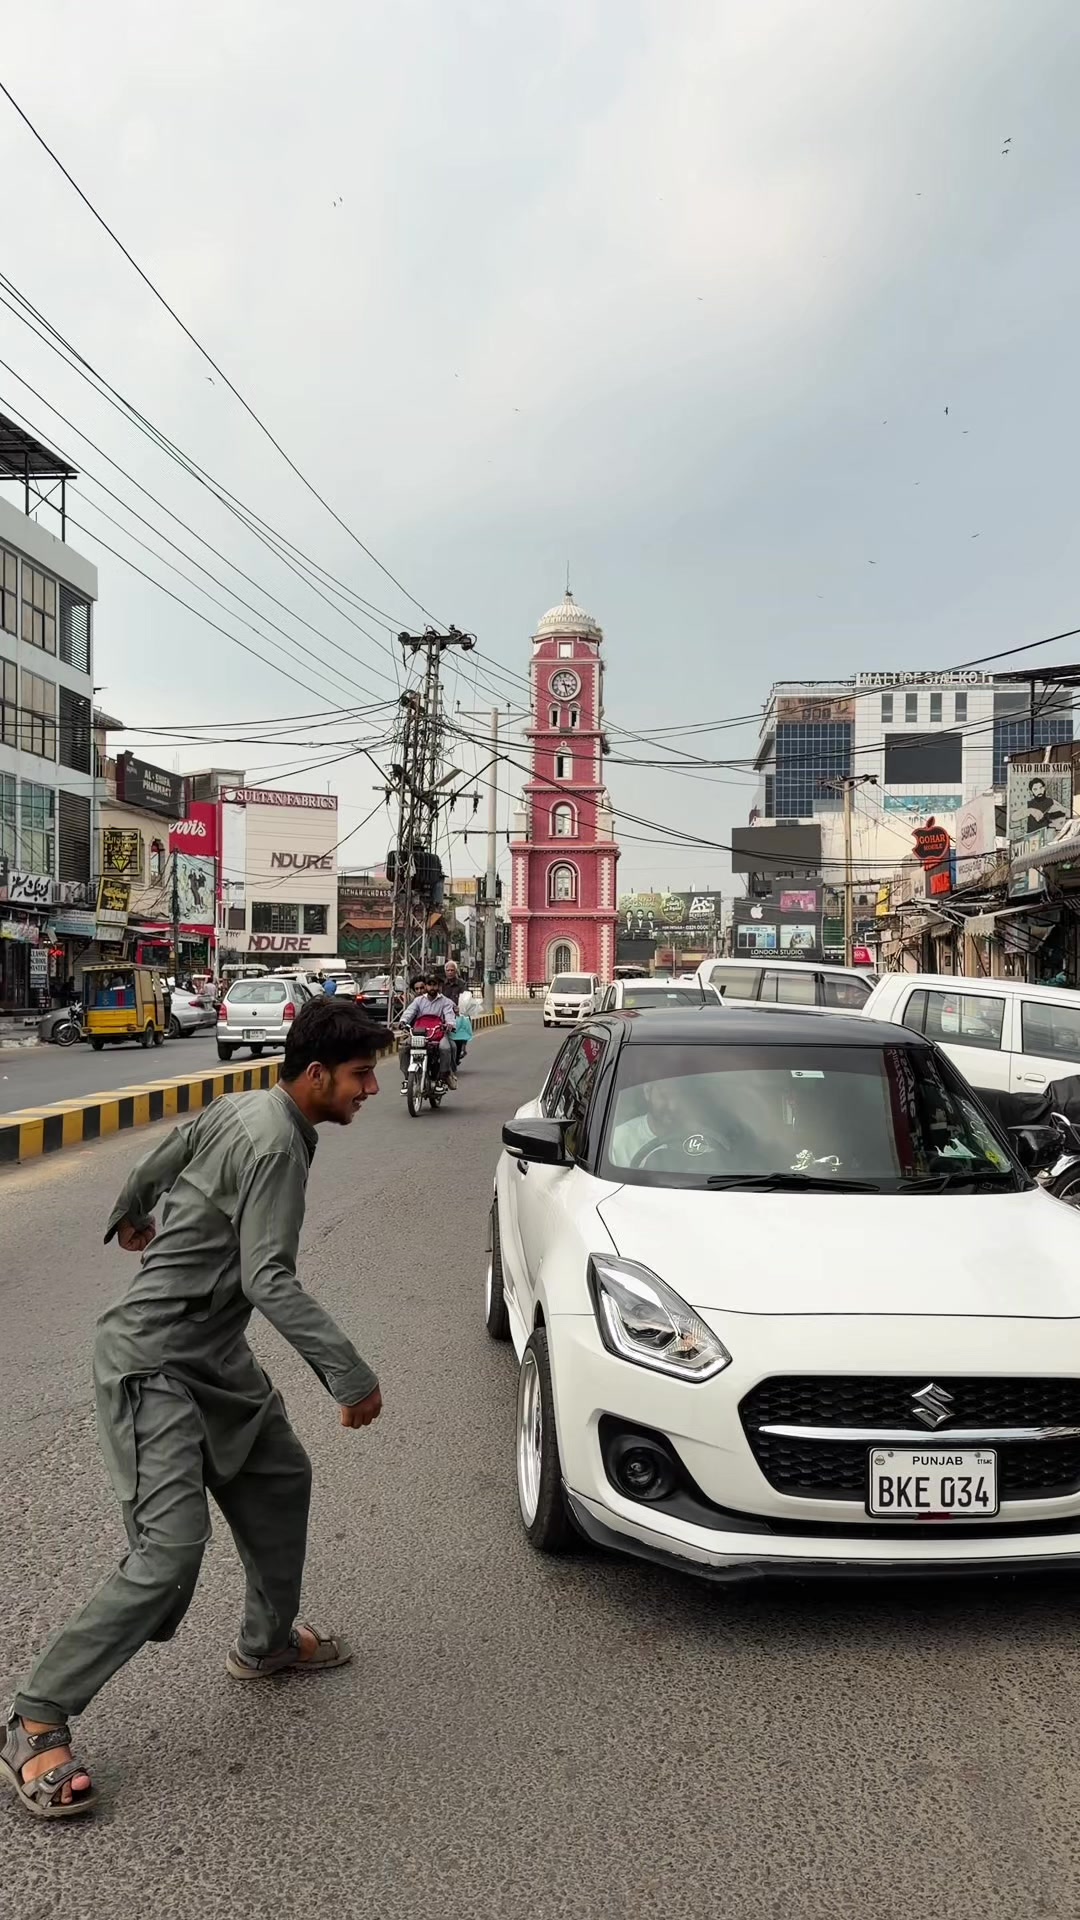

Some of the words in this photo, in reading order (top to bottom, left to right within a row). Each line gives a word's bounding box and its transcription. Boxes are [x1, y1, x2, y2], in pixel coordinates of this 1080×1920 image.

[903, 672, 921, 685] OF
[923, 671, 988, 684] SIALKOT
[1012, 763, 1032, 773] STYLO
[1033, 763, 1050, 773] HAIR
[1051, 763, 1072, 773] SALON
[236, 790, 283, 805] SULTAN
[284, 794, 337, 809] FABRICS
[919, 834, 946, 844] GOHAR
[271, 852, 333, 870] NDURE
[248, 935, 312, 951] NDURE
[912, 1456, 963, 1466] PUNJAB
[879, 1476, 930, 1508] BKE
[940, 1476, 989, 1508] 034
